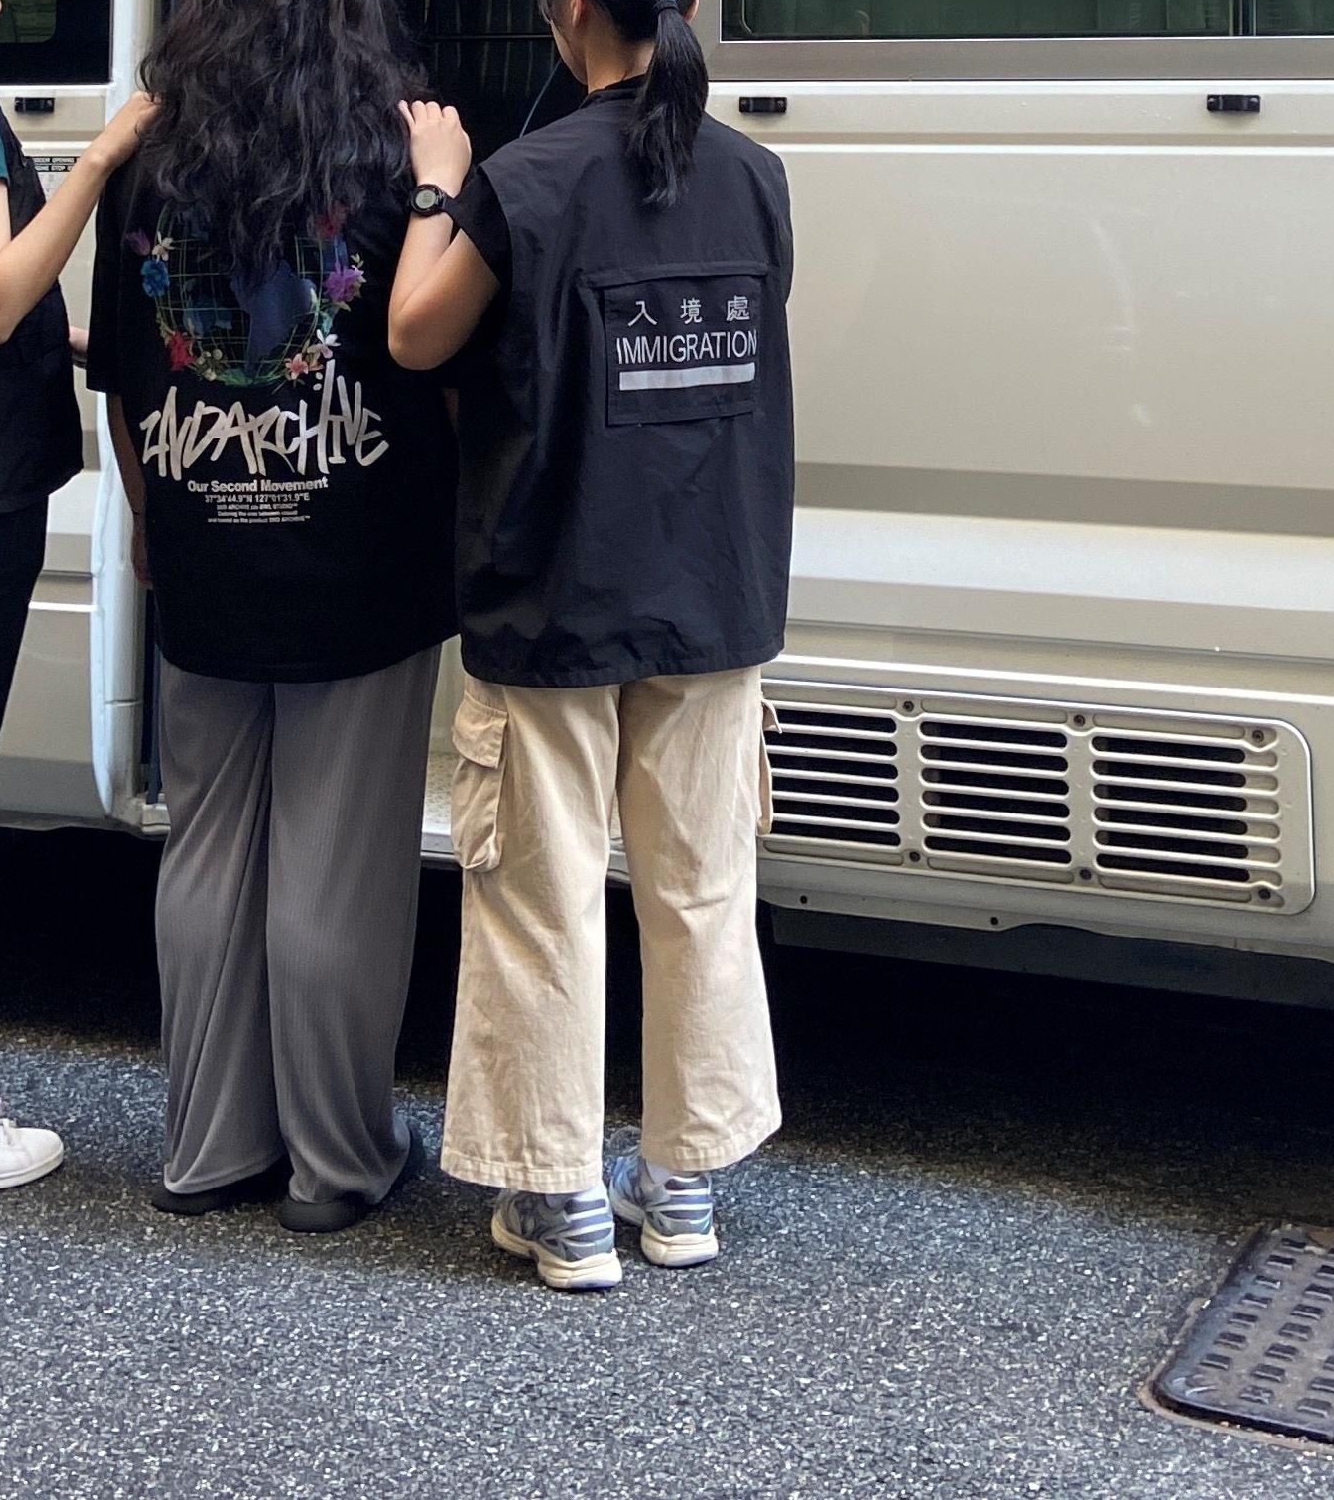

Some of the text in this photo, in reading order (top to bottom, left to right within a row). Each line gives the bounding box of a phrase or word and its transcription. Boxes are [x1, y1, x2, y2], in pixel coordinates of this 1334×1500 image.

[628, 295, 750, 327] 入境處
[616, 329, 757, 365] IMMIGRATION
[187, 476, 328, 492] Our Second Movement
